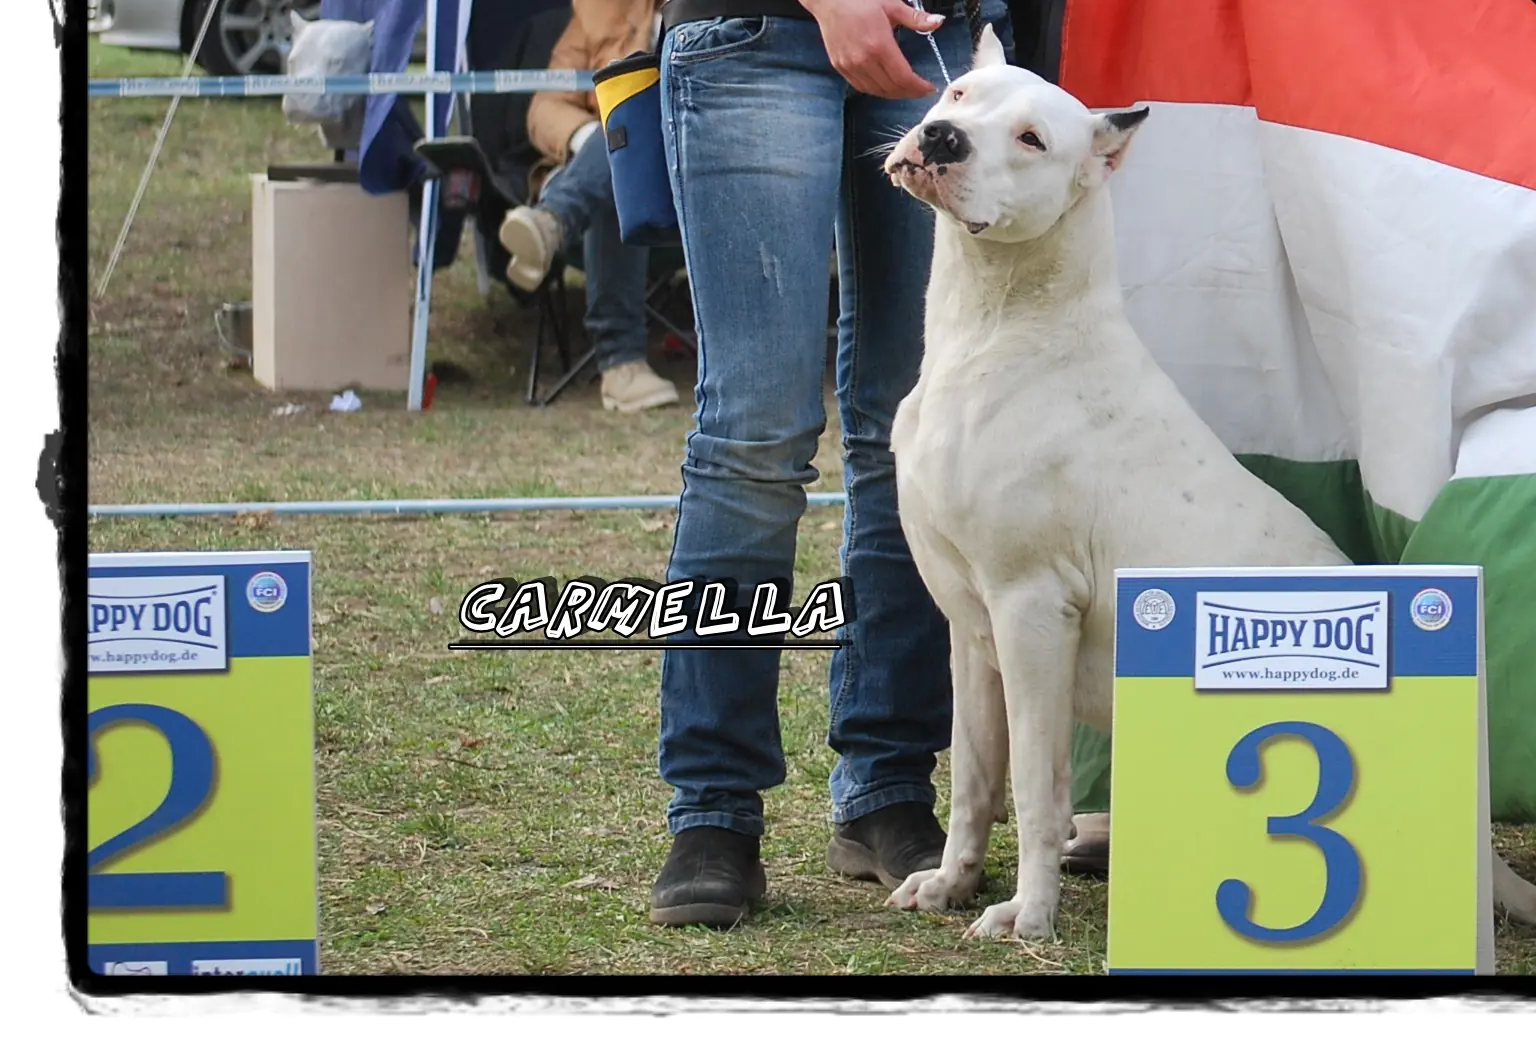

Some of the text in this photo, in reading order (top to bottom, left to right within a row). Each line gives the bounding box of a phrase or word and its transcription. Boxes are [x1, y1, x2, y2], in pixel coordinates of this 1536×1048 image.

[255, 588, 278, 597] FCI
[88, 597, 211, 637] PPY DOG
[1420, 605, 1442, 615] FCI
[1207, 612, 1374, 657] HAPPY DOG
[88, 649, 199, 664] w.happydog.de
[1222, 667, 1360, 683] www.happydog.de
[88, 703, 225, 909] 2
[1216, 721, 1362, 942] 3
